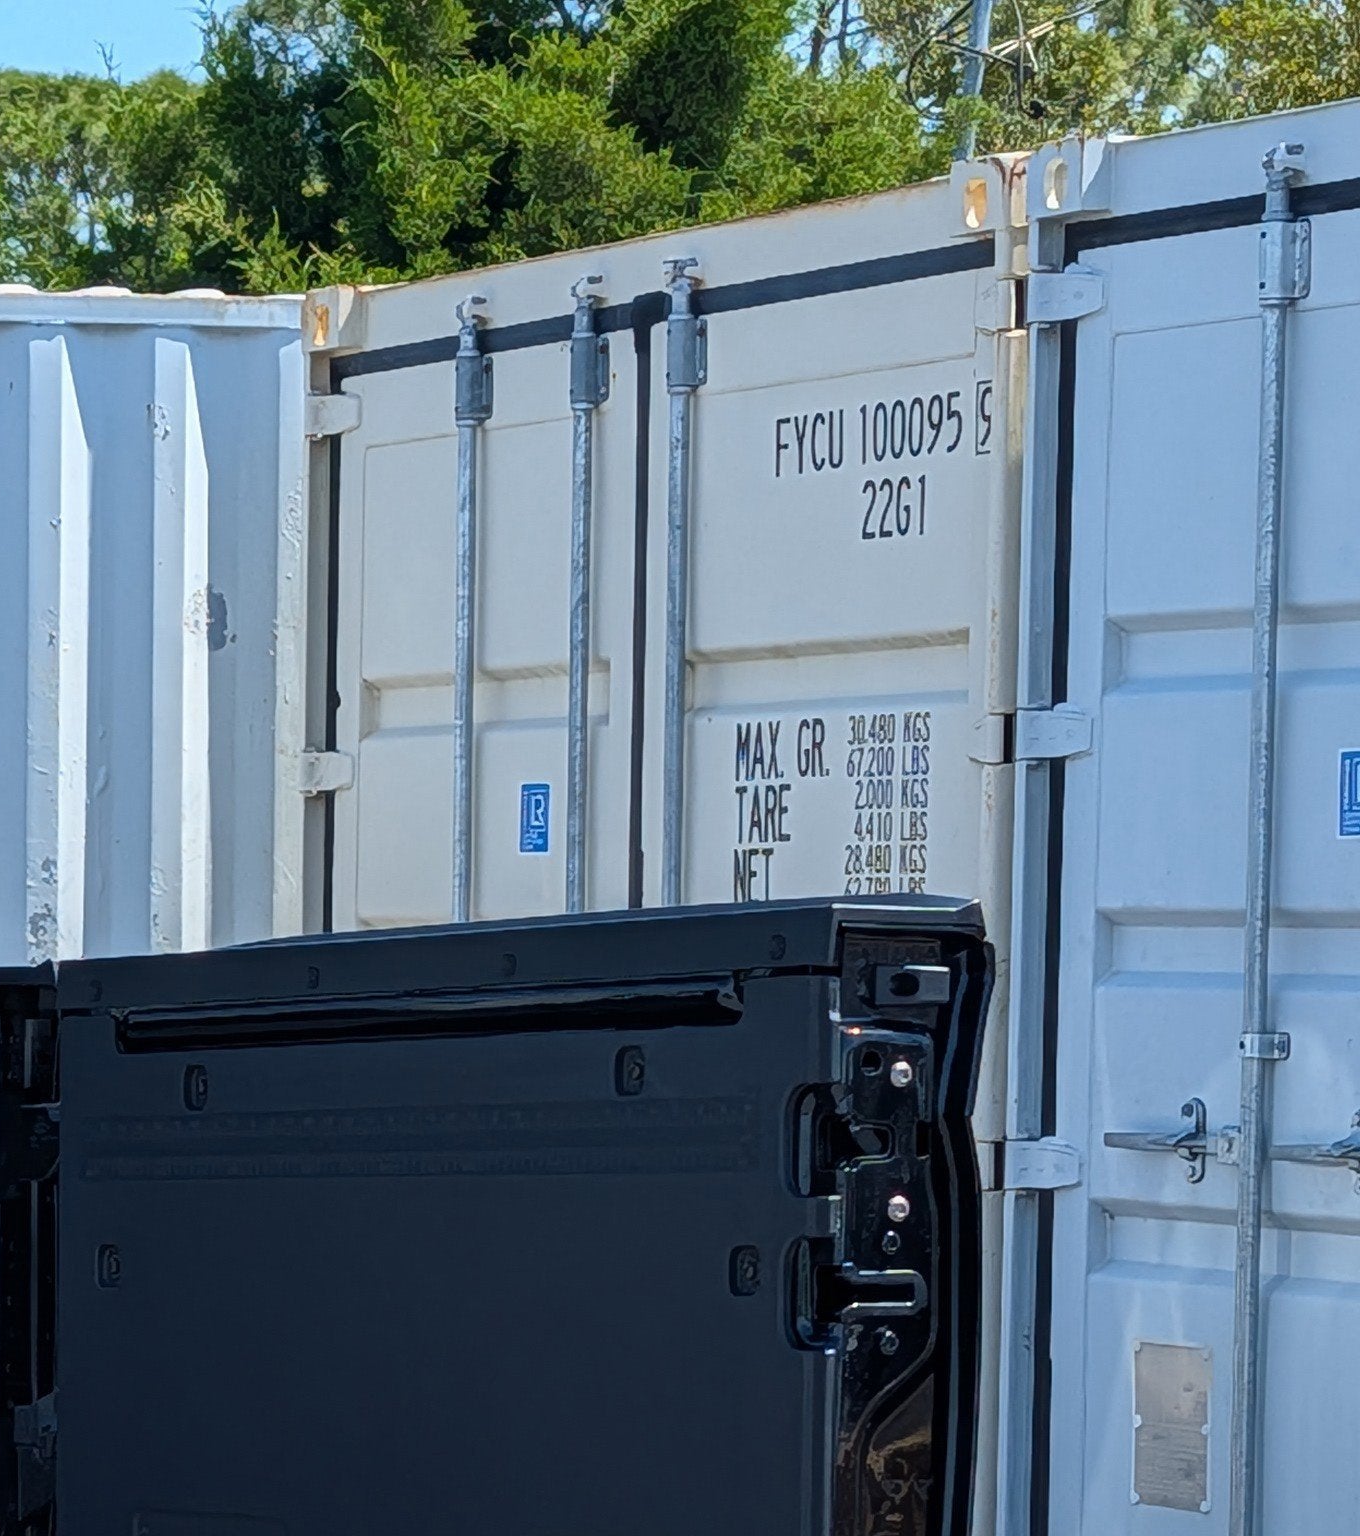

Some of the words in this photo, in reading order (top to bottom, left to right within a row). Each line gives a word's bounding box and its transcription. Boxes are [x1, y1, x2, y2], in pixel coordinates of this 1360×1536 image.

[776, 408, 844, 477] FYCU
[859, 390, 963, 465] 100095
[862, 474, 926, 539] 22G1
[797, 718, 830, 777] GR.
[903, 711, 931, 743] KGS
[901, 744, 930, 776] LBS
[735, 783, 792, 845] TARE
[901, 777, 929, 809] KGS
[900, 811, 928, 842] LBS
[734, 847, 775, 902] NET
[899, 844, 927, 875] KGS
